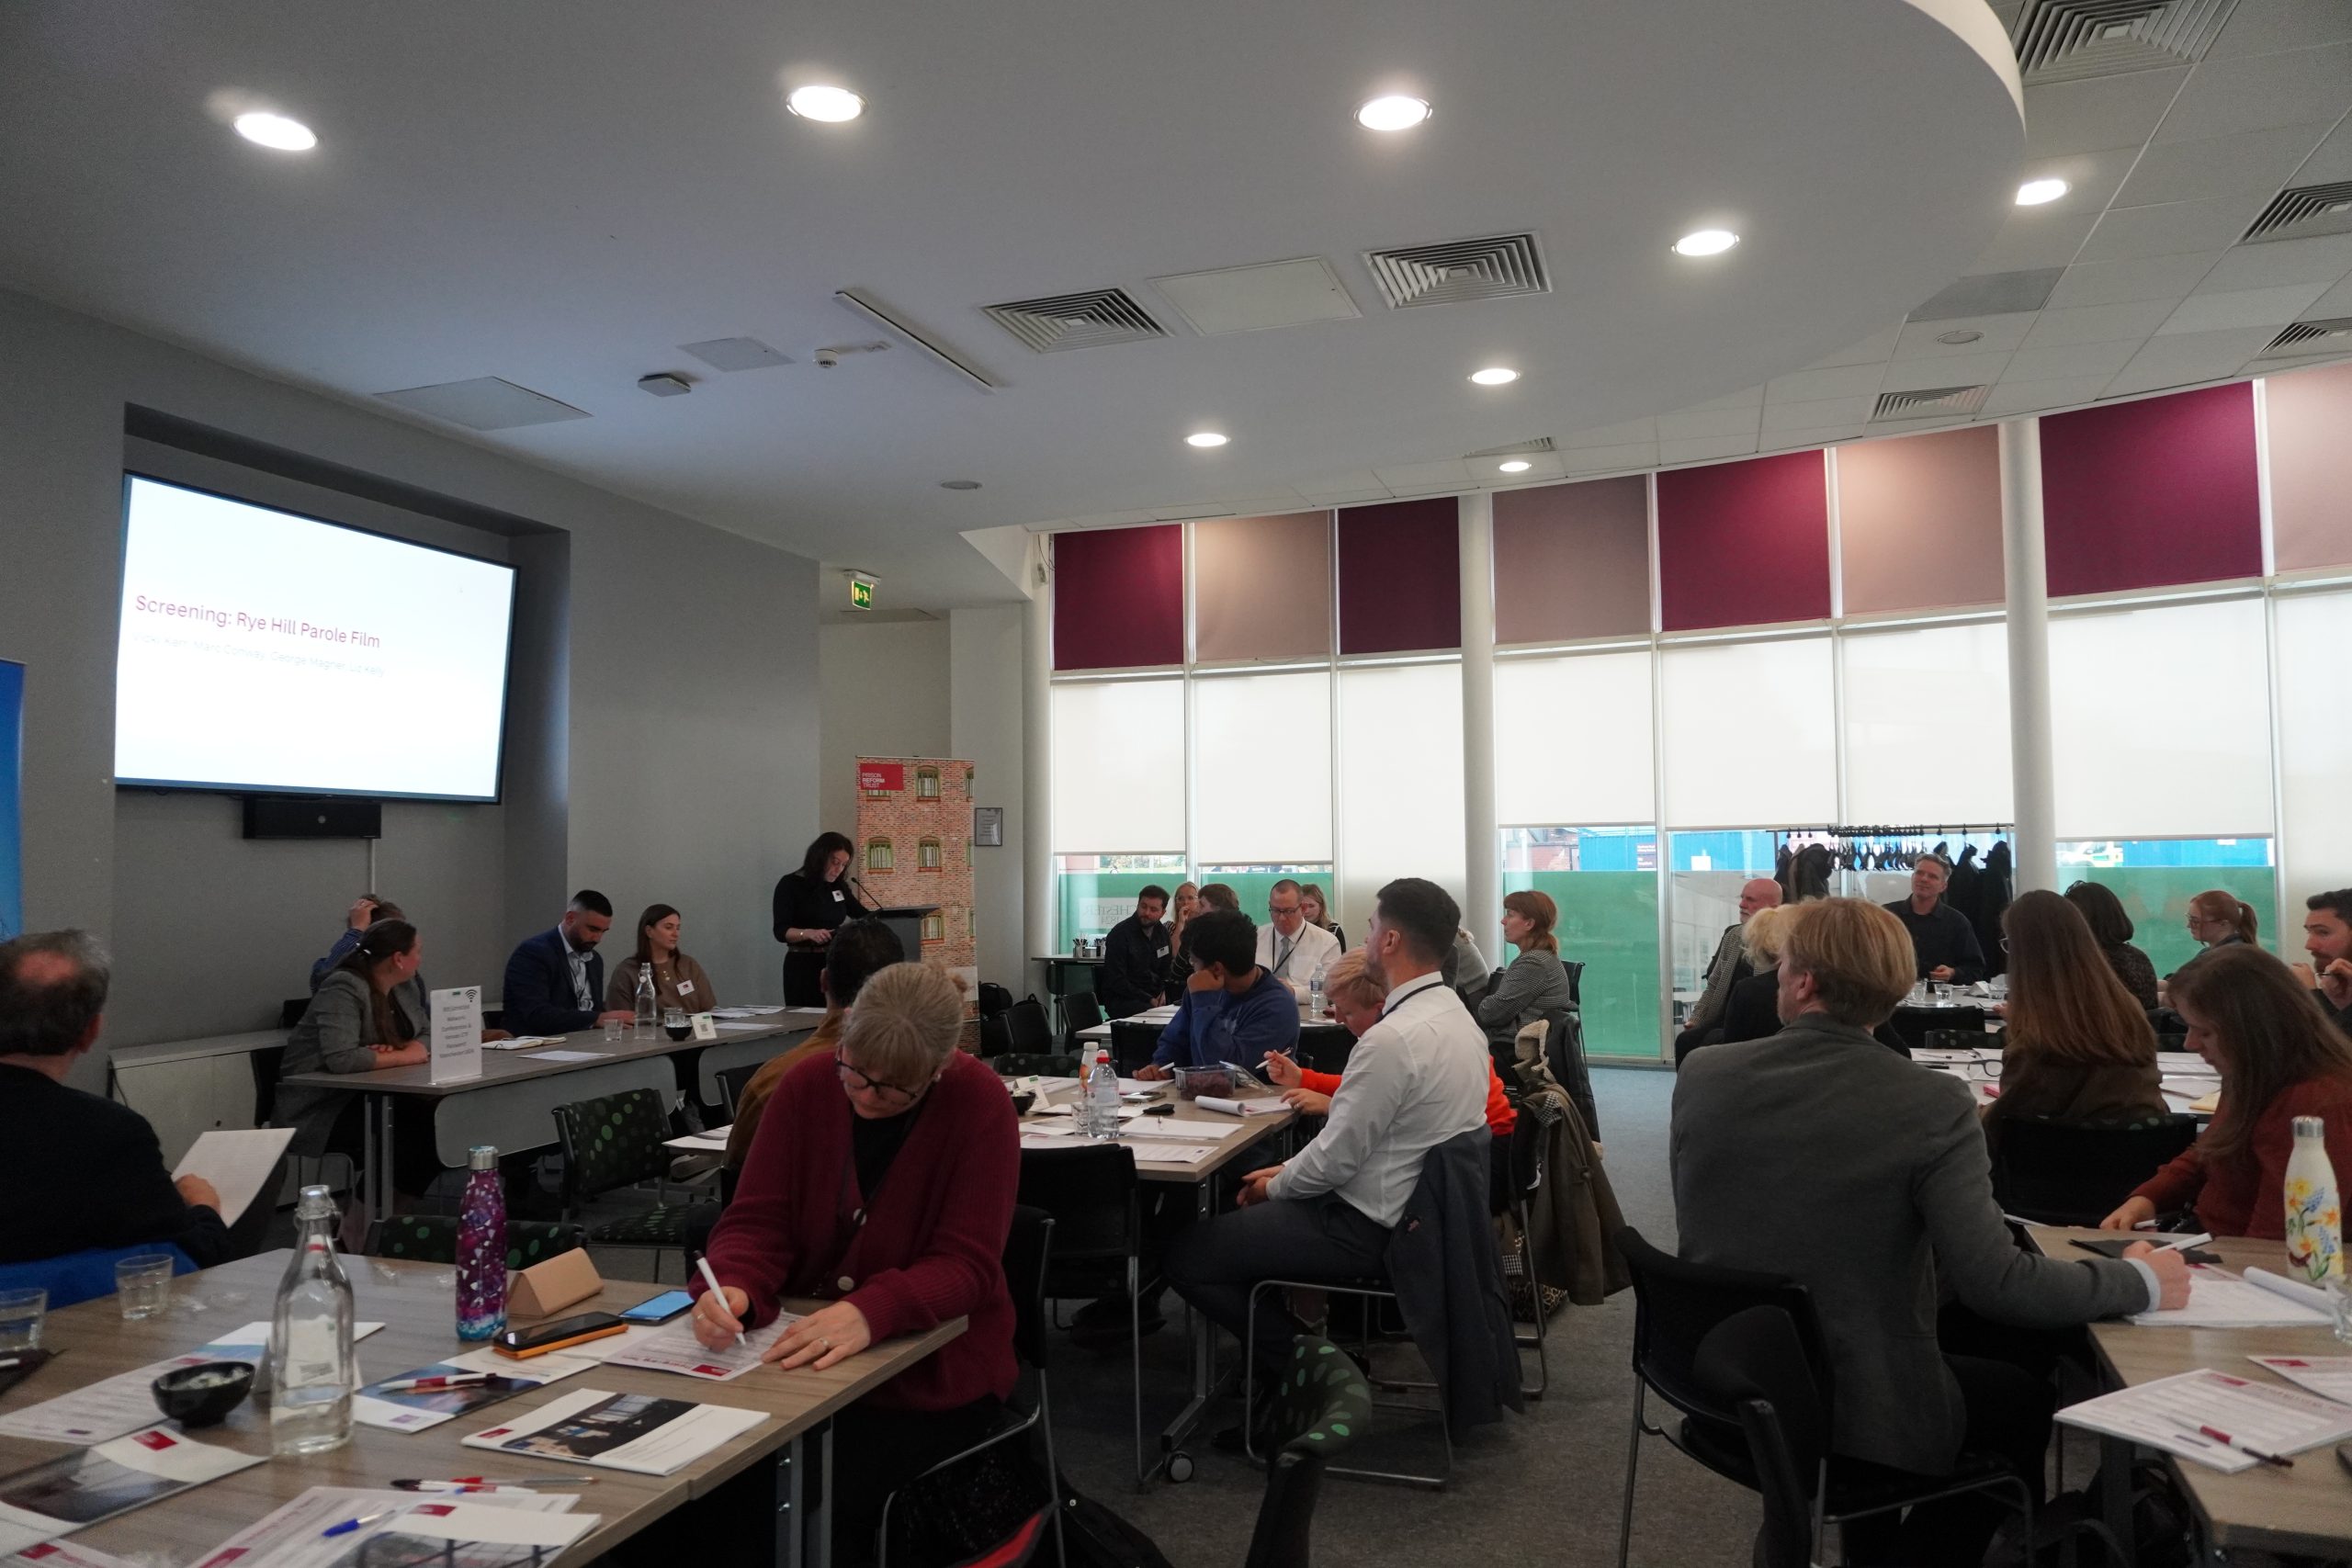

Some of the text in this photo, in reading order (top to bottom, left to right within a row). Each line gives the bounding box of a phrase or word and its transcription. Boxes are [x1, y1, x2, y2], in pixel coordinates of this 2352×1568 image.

[135, 594, 381, 649] Screening: Rye Hill Parole Film
